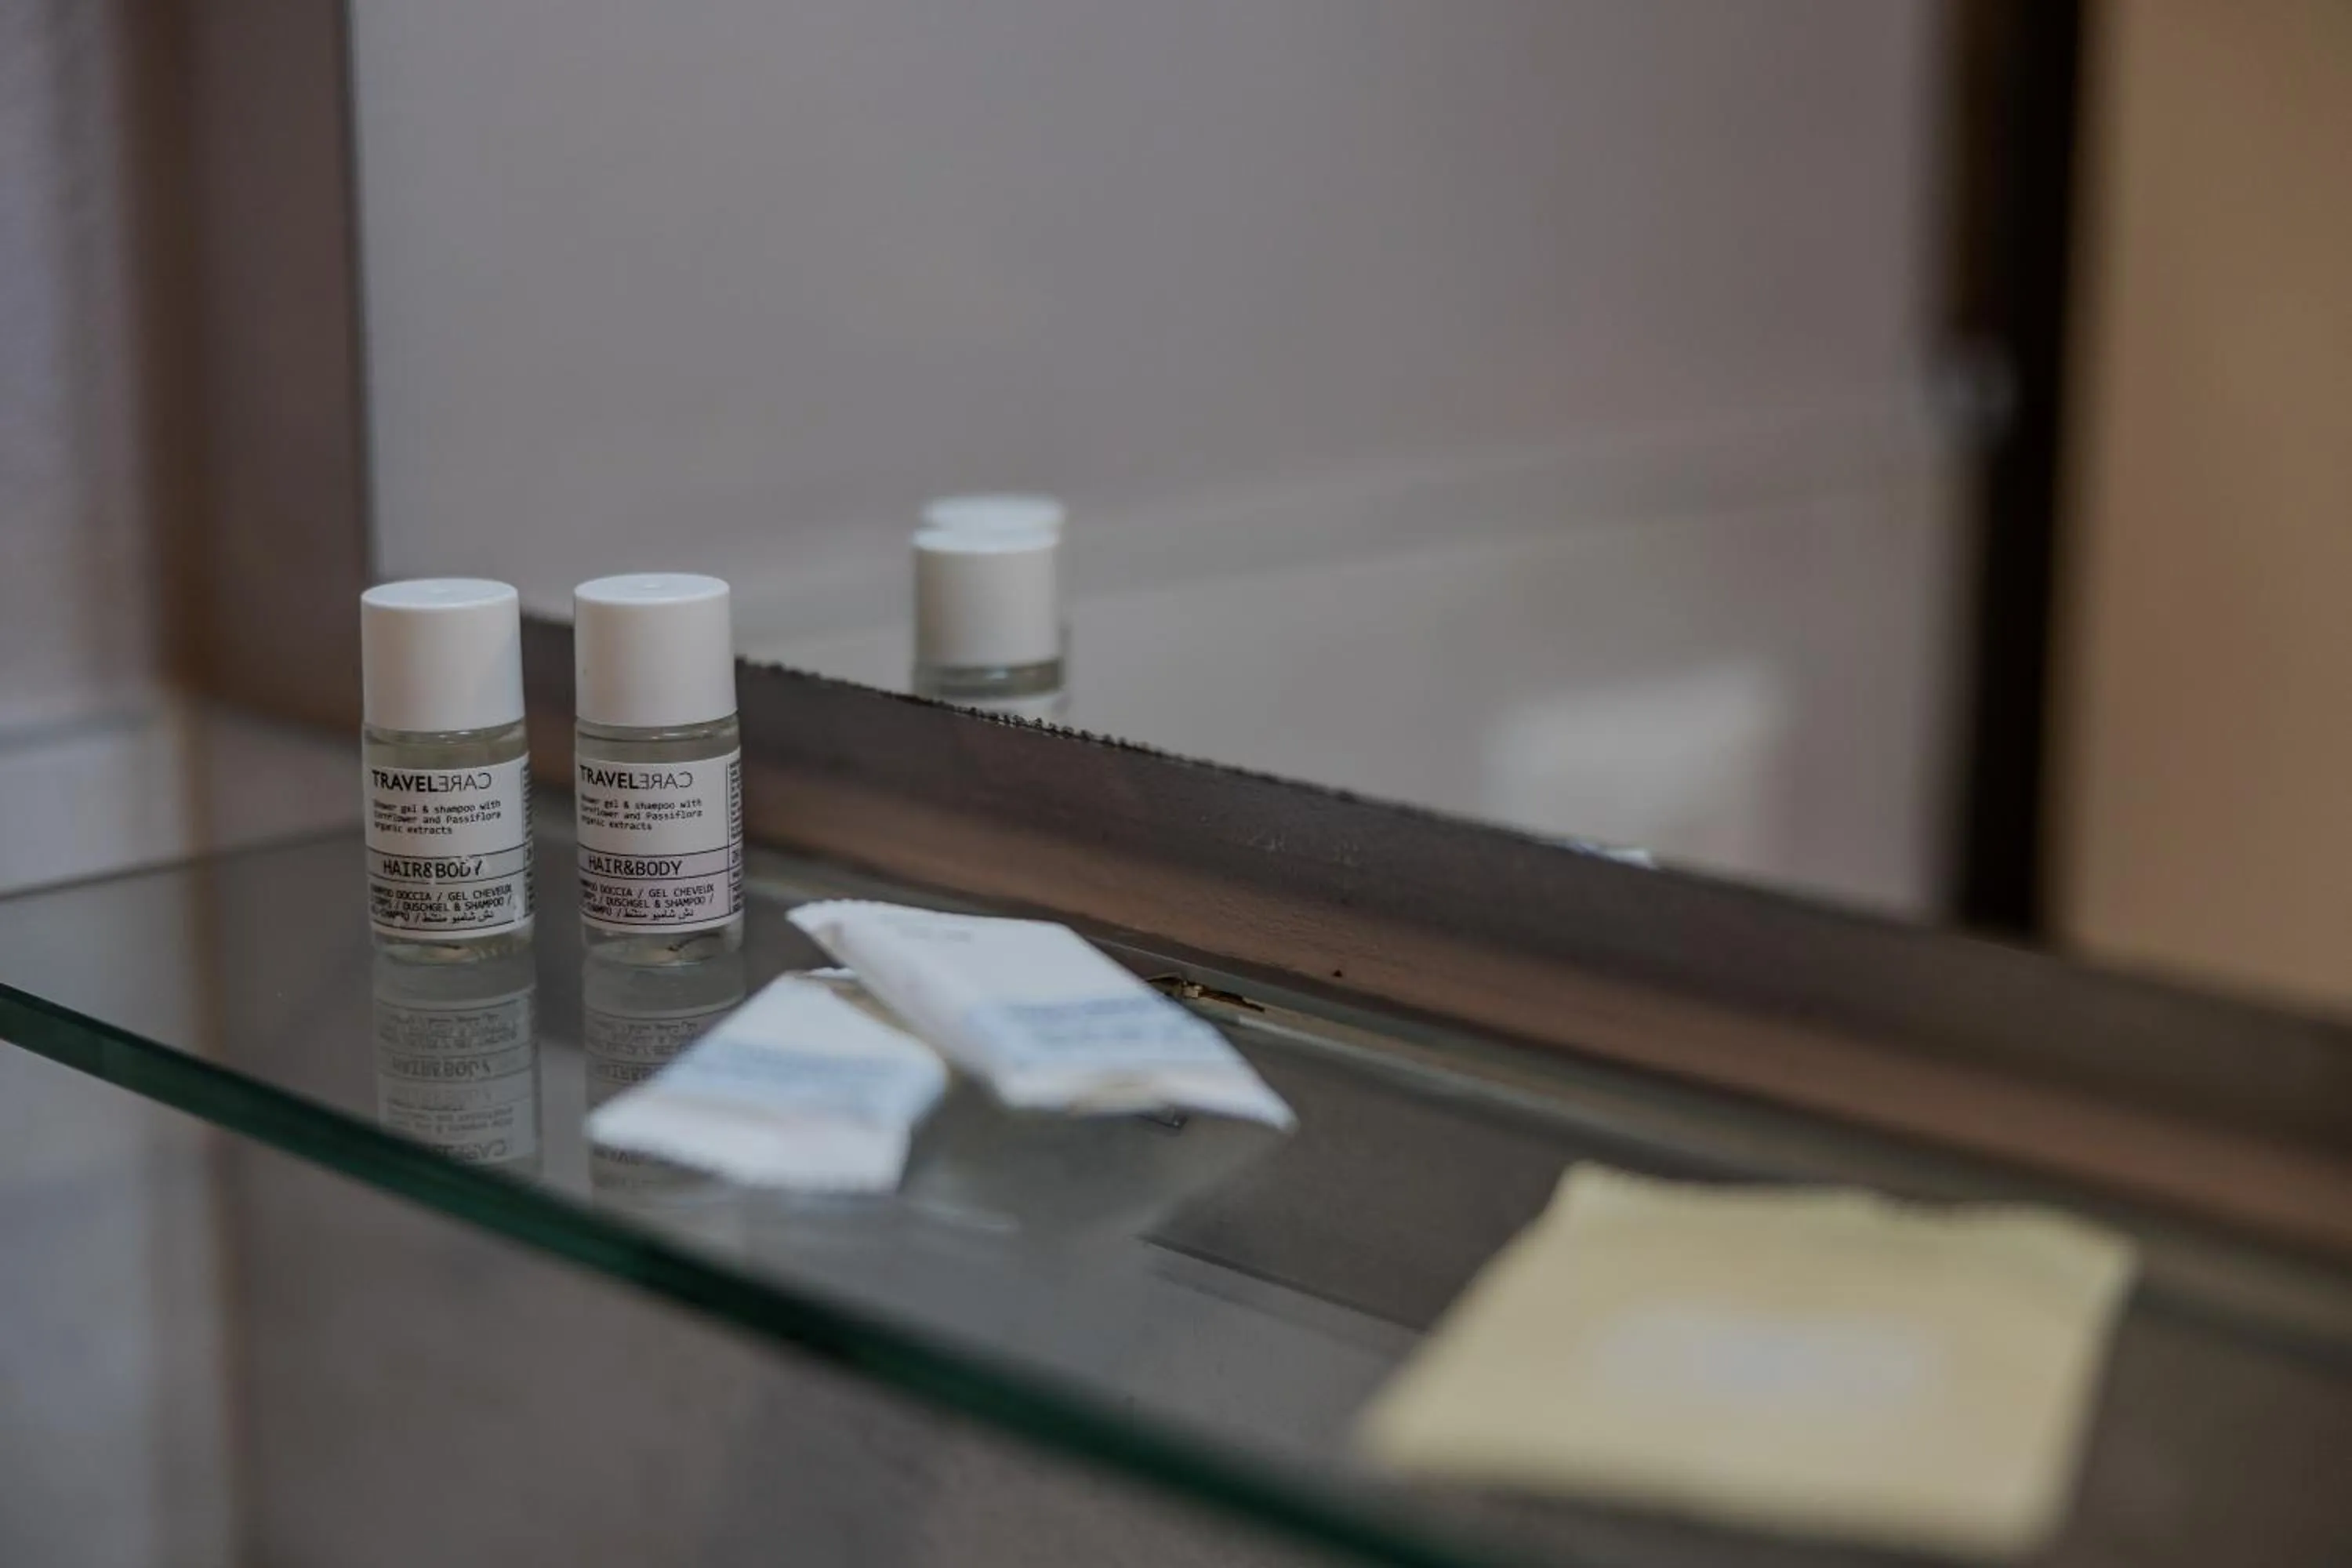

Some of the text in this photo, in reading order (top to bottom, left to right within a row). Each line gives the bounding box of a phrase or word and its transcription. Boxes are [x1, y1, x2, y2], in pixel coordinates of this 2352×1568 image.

[372, 769, 438, 793] TRAVEL
[579, 765, 639, 789] TRAVEL
[434, 803, 476, 815] shampoo
[480, 800, 501, 811] with
[635, 800, 675, 811] shampoo
[680, 798, 702, 808] with
[423, 815, 441, 824] and
[589, 855, 682, 876] HAIR&BODY
[448, 890, 468, 901] GEL
[648, 888, 668, 898] GEL
[673, 884, 714, 896] CHEVEUX
[465, 897, 504, 911] SHAMPOO
[665, 896, 706, 908] SHAMPOO
